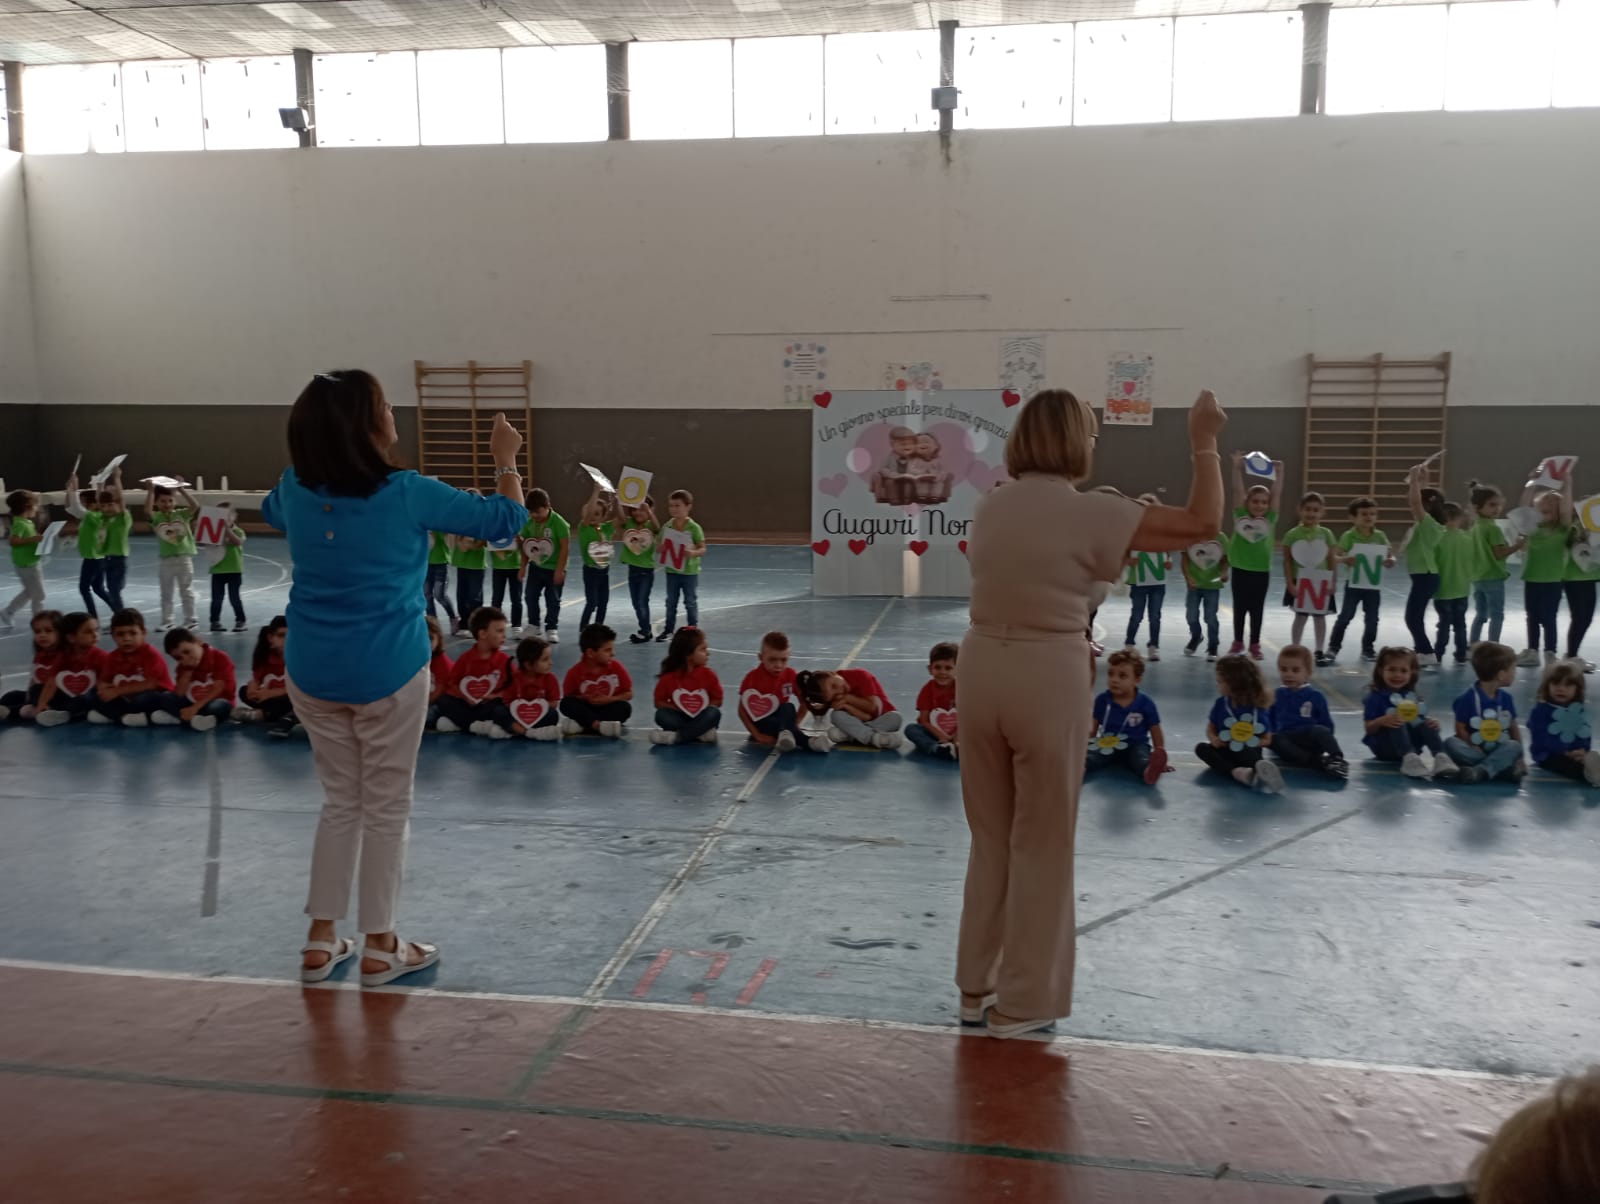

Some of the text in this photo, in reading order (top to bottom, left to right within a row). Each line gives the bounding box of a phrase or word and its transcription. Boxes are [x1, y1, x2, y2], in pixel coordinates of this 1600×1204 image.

[818, 425, 838, 442] Un
[839, 412, 875, 438] giorno
[877, 400, 921, 425] speciale
[922, 405, 943, 421] per
[617, 476, 647, 505] O
[196, 516, 225, 544] N
[823, 508, 918, 545] Auguri
[659, 538, 686, 570] N
[1137, 551, 1165, 583] N
[1351, 553, 1384, 586] N
[1297, 577, 1328, 611] N
